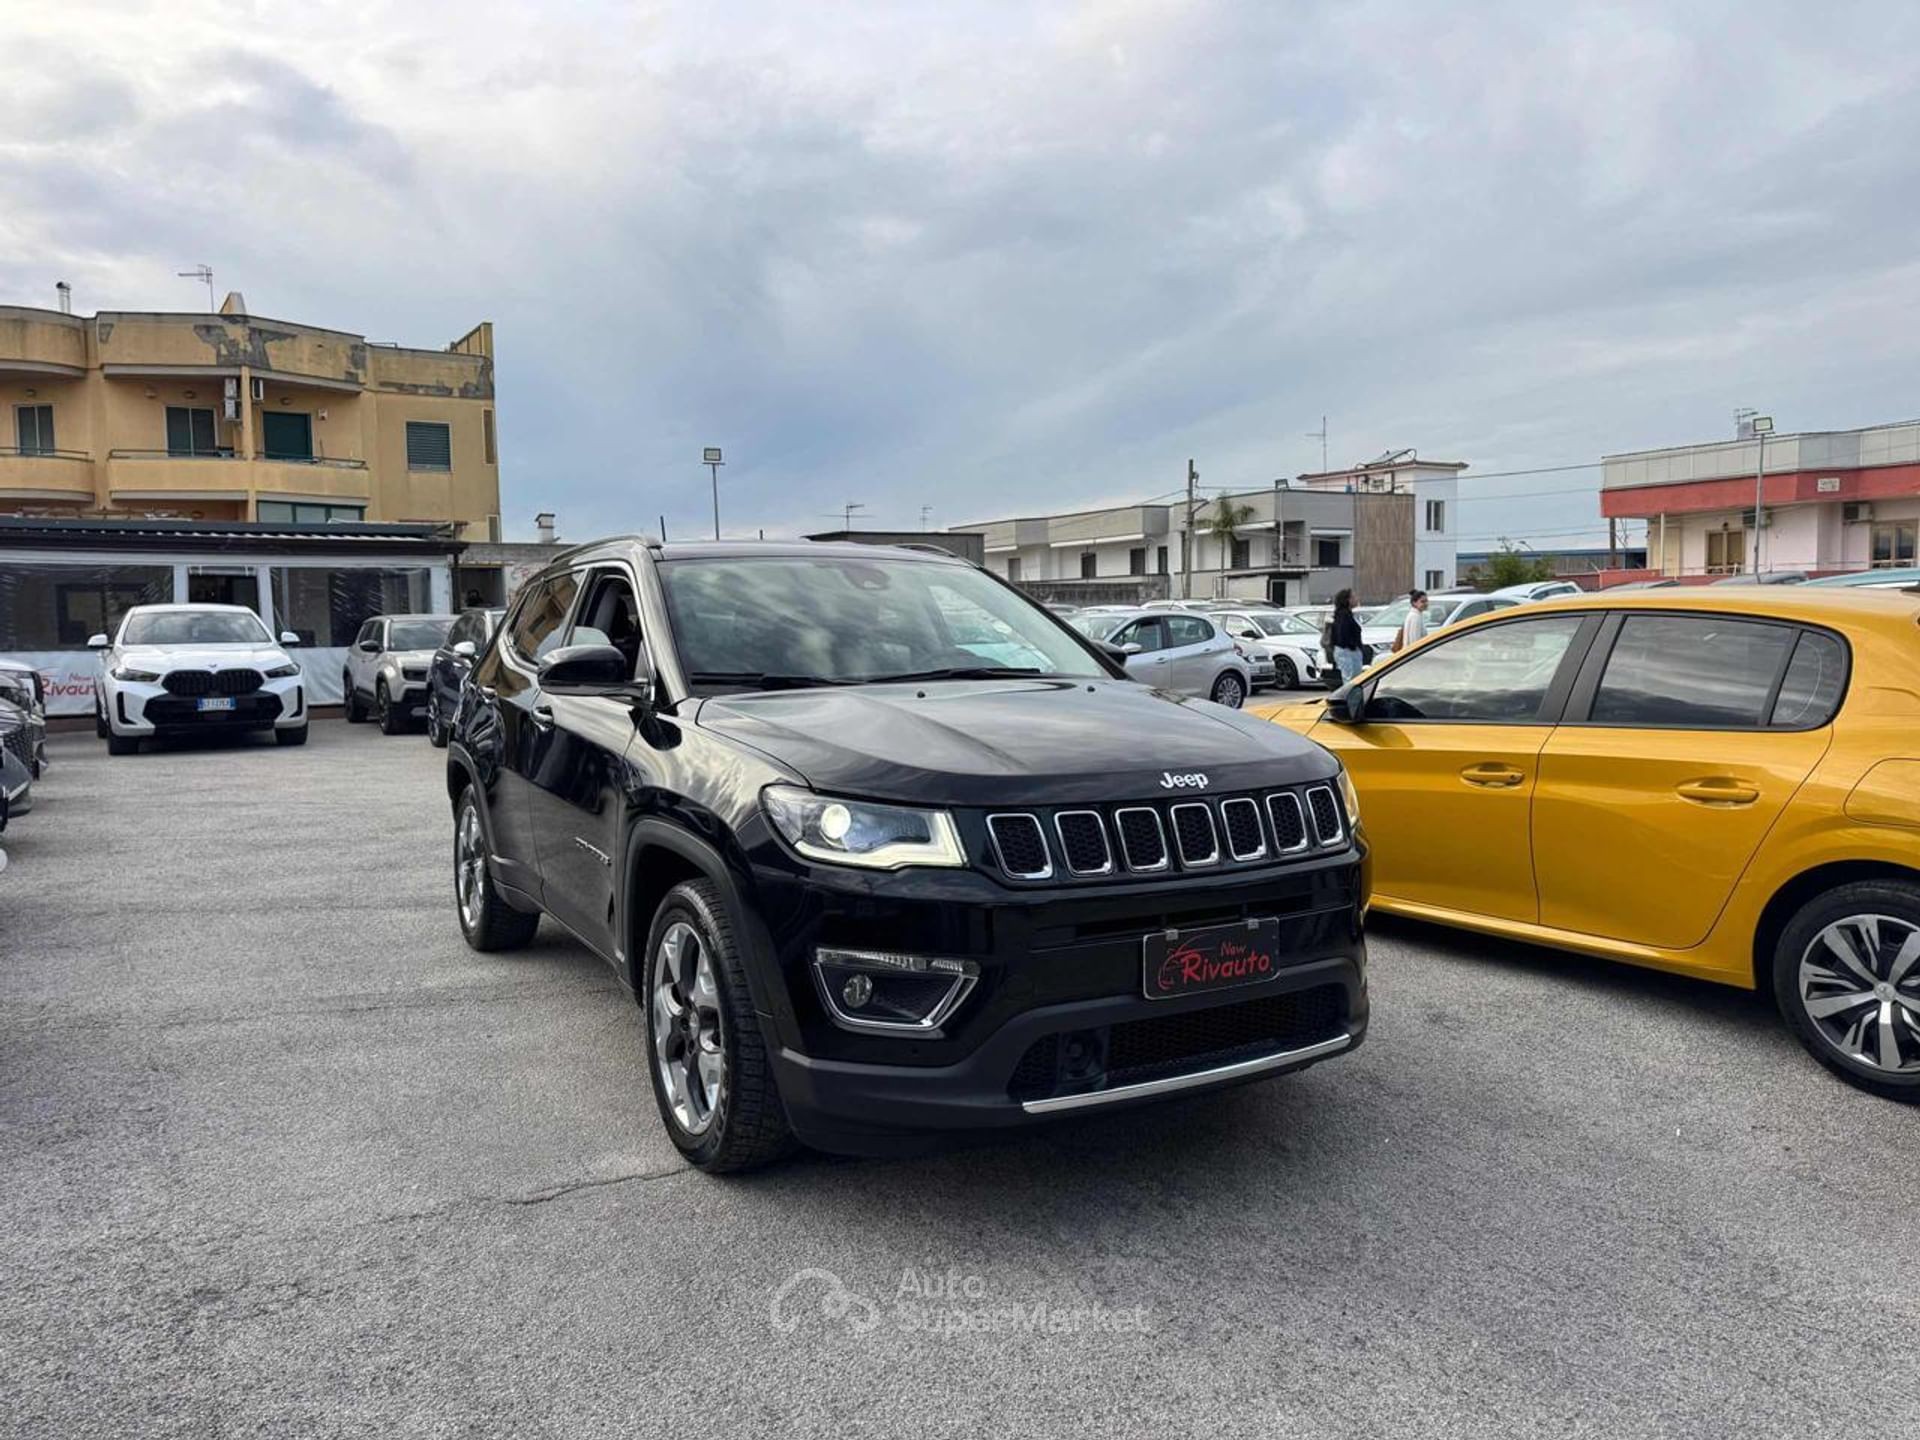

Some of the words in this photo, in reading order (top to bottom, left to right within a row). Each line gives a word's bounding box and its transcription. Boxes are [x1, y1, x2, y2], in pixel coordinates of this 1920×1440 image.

[1159, 771, 1209, 789] Jeep
[1220, 940, 1247, 957] New
[1180, 950, 1270, 985] Rivauto
